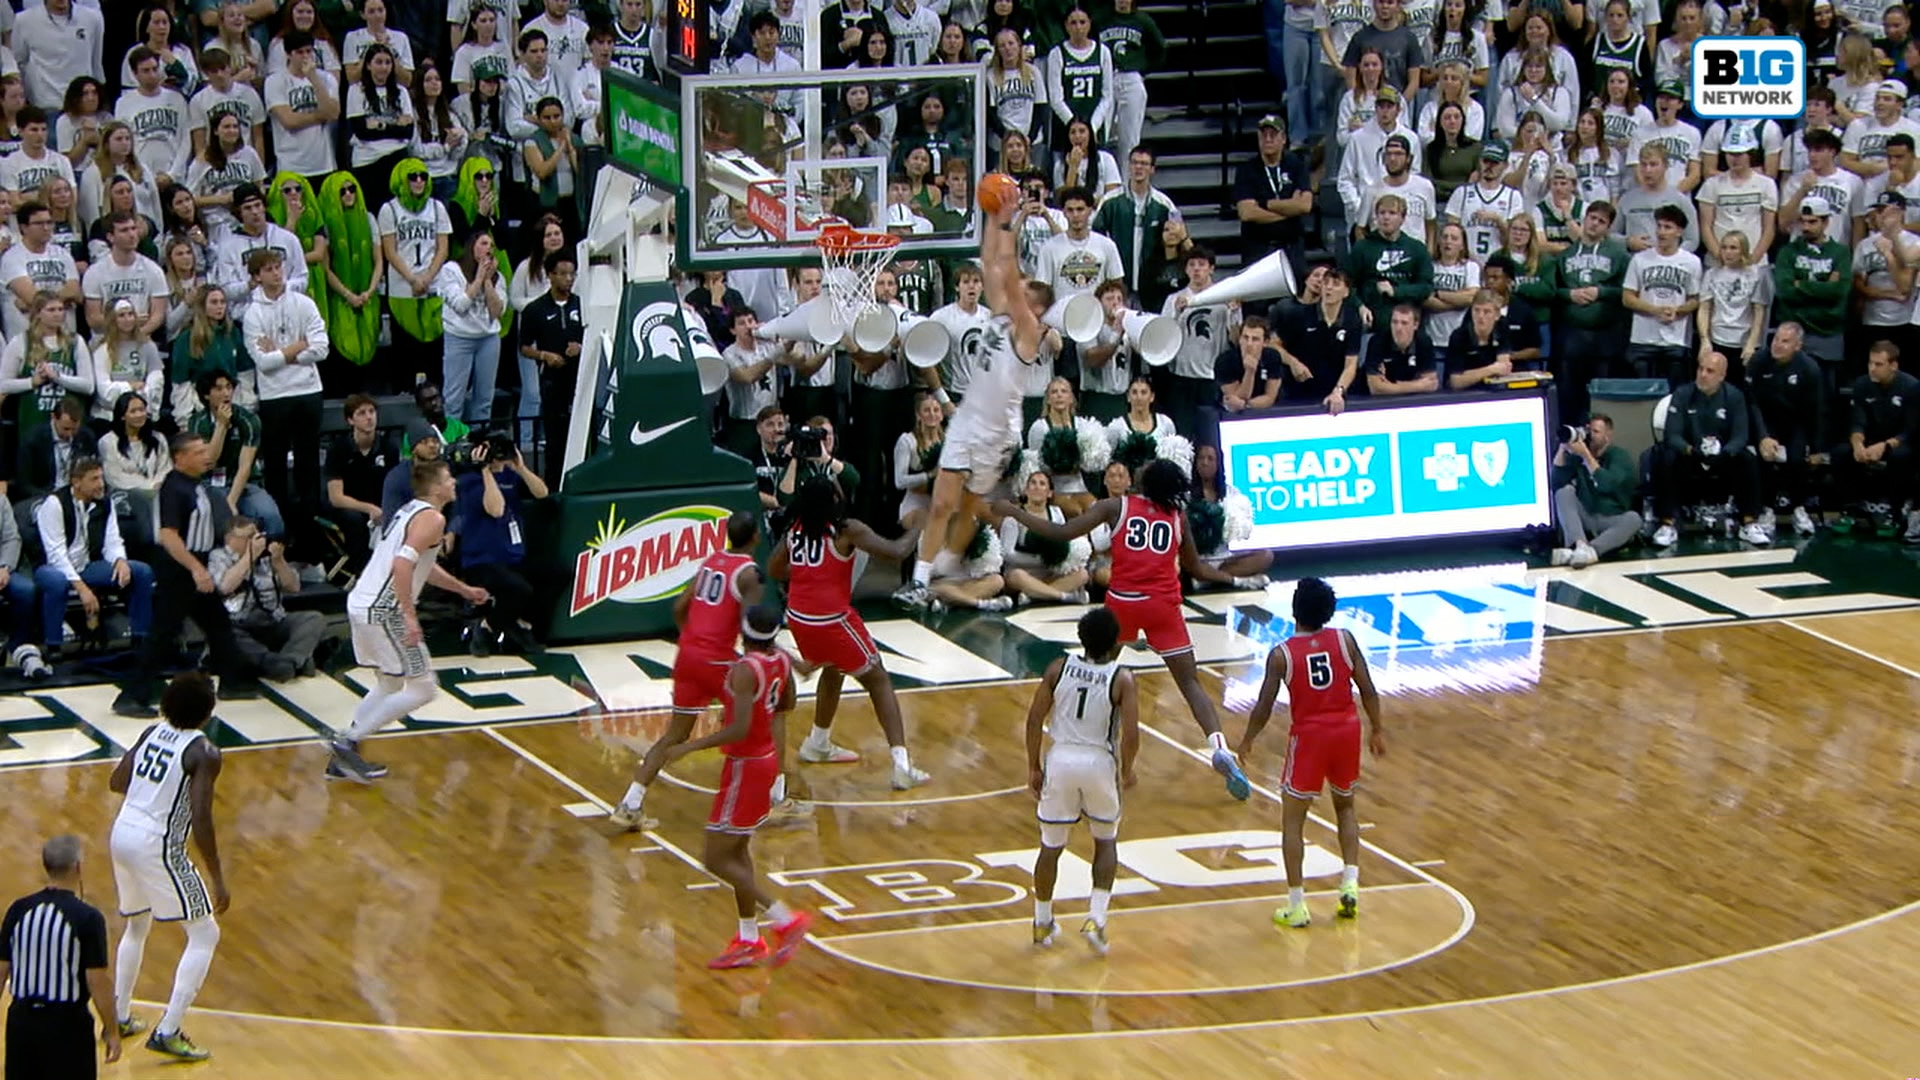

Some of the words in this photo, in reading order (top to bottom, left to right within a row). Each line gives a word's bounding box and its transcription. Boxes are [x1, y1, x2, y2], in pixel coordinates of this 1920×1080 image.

[1073, 77, 1094, 97] 21
[134, 108, 178, 131] IZZONE
[398, 225, 435, 240] STATE
[1476, 232, 1490, 254] 5
[413, 242, 422, 266] 1
[899, 274, 926, 291] TATE
[900, 291, 919, 312] 11
[1247, 446, 1375, 483] READY
[1251, 486, 1290, 511] TO
[1295, 479, 1376, 509] HELP
[790, 531, 825, 567] 20
[1125, 516, 1172, 554] 30
[571, 513, 731, 616] LIBMAN
[695, 566, 726, 606] 10
[1306, 650, 1333, 690] 5
[1076, 687, 1089, 719] 1
[135, 743, 174, 784] 55
